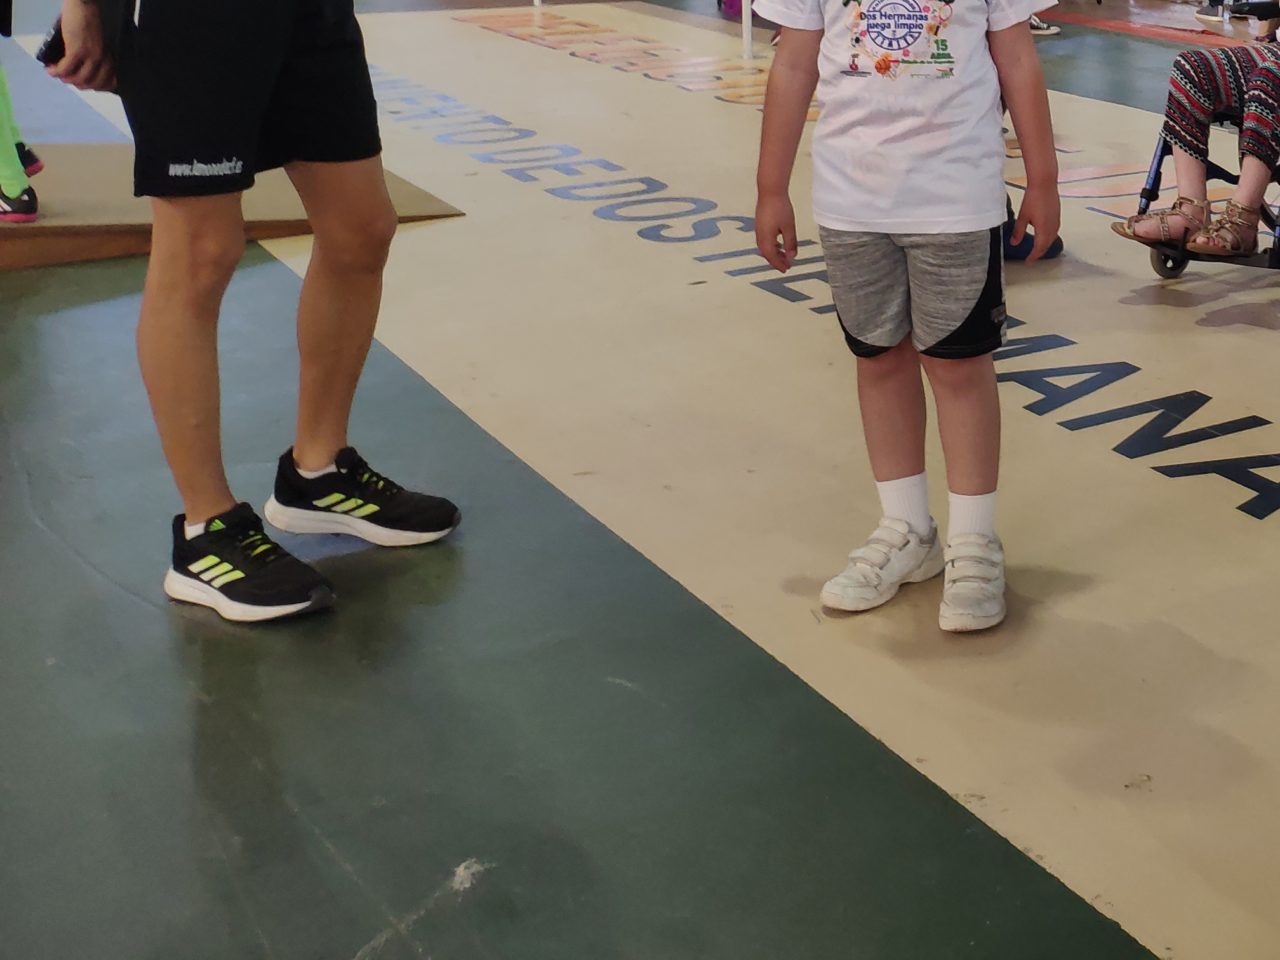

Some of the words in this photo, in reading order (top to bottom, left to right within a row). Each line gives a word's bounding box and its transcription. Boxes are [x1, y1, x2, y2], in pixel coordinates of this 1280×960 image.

[860, 12, 877, 21] Dos
[880, 11, 929, 23] Hermanas
[867, 21, 891, 31] juega
[894, 20, 924, 30] limpio
[934, 39, 948, 52] 15
[470, 143, 626, 183] DE
[543, 175, 758, 241] DOS
